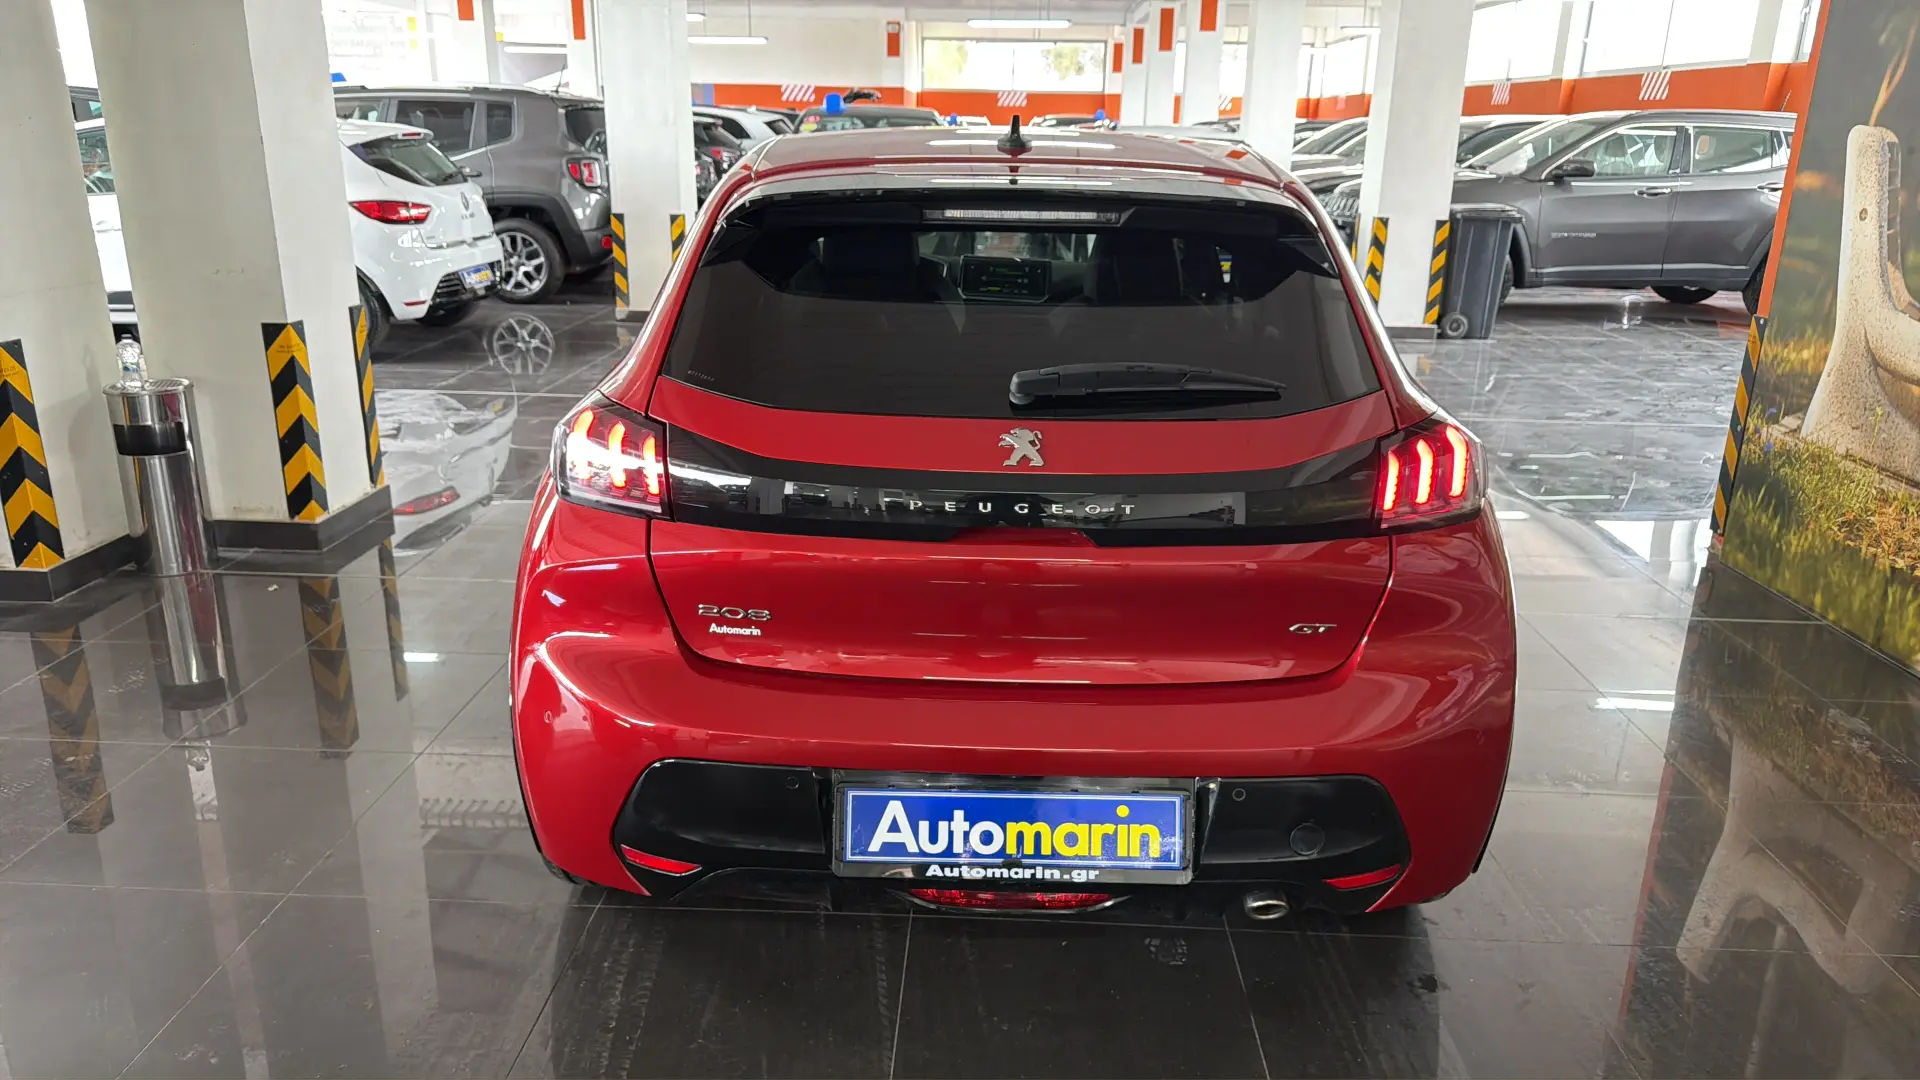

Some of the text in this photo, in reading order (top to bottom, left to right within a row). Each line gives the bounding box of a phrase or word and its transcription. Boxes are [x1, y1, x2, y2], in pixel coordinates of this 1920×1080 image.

[908, 499, 1136, 516] PEUGEOT
[698, 603, 772, 621] 208
[709, 623, 761, 636] Automarin
[1288, 623, 1338, 634] GT
[867, 800, 1161, 858] Automarin
[925, 864, 1099, 882] Automarin.gr
